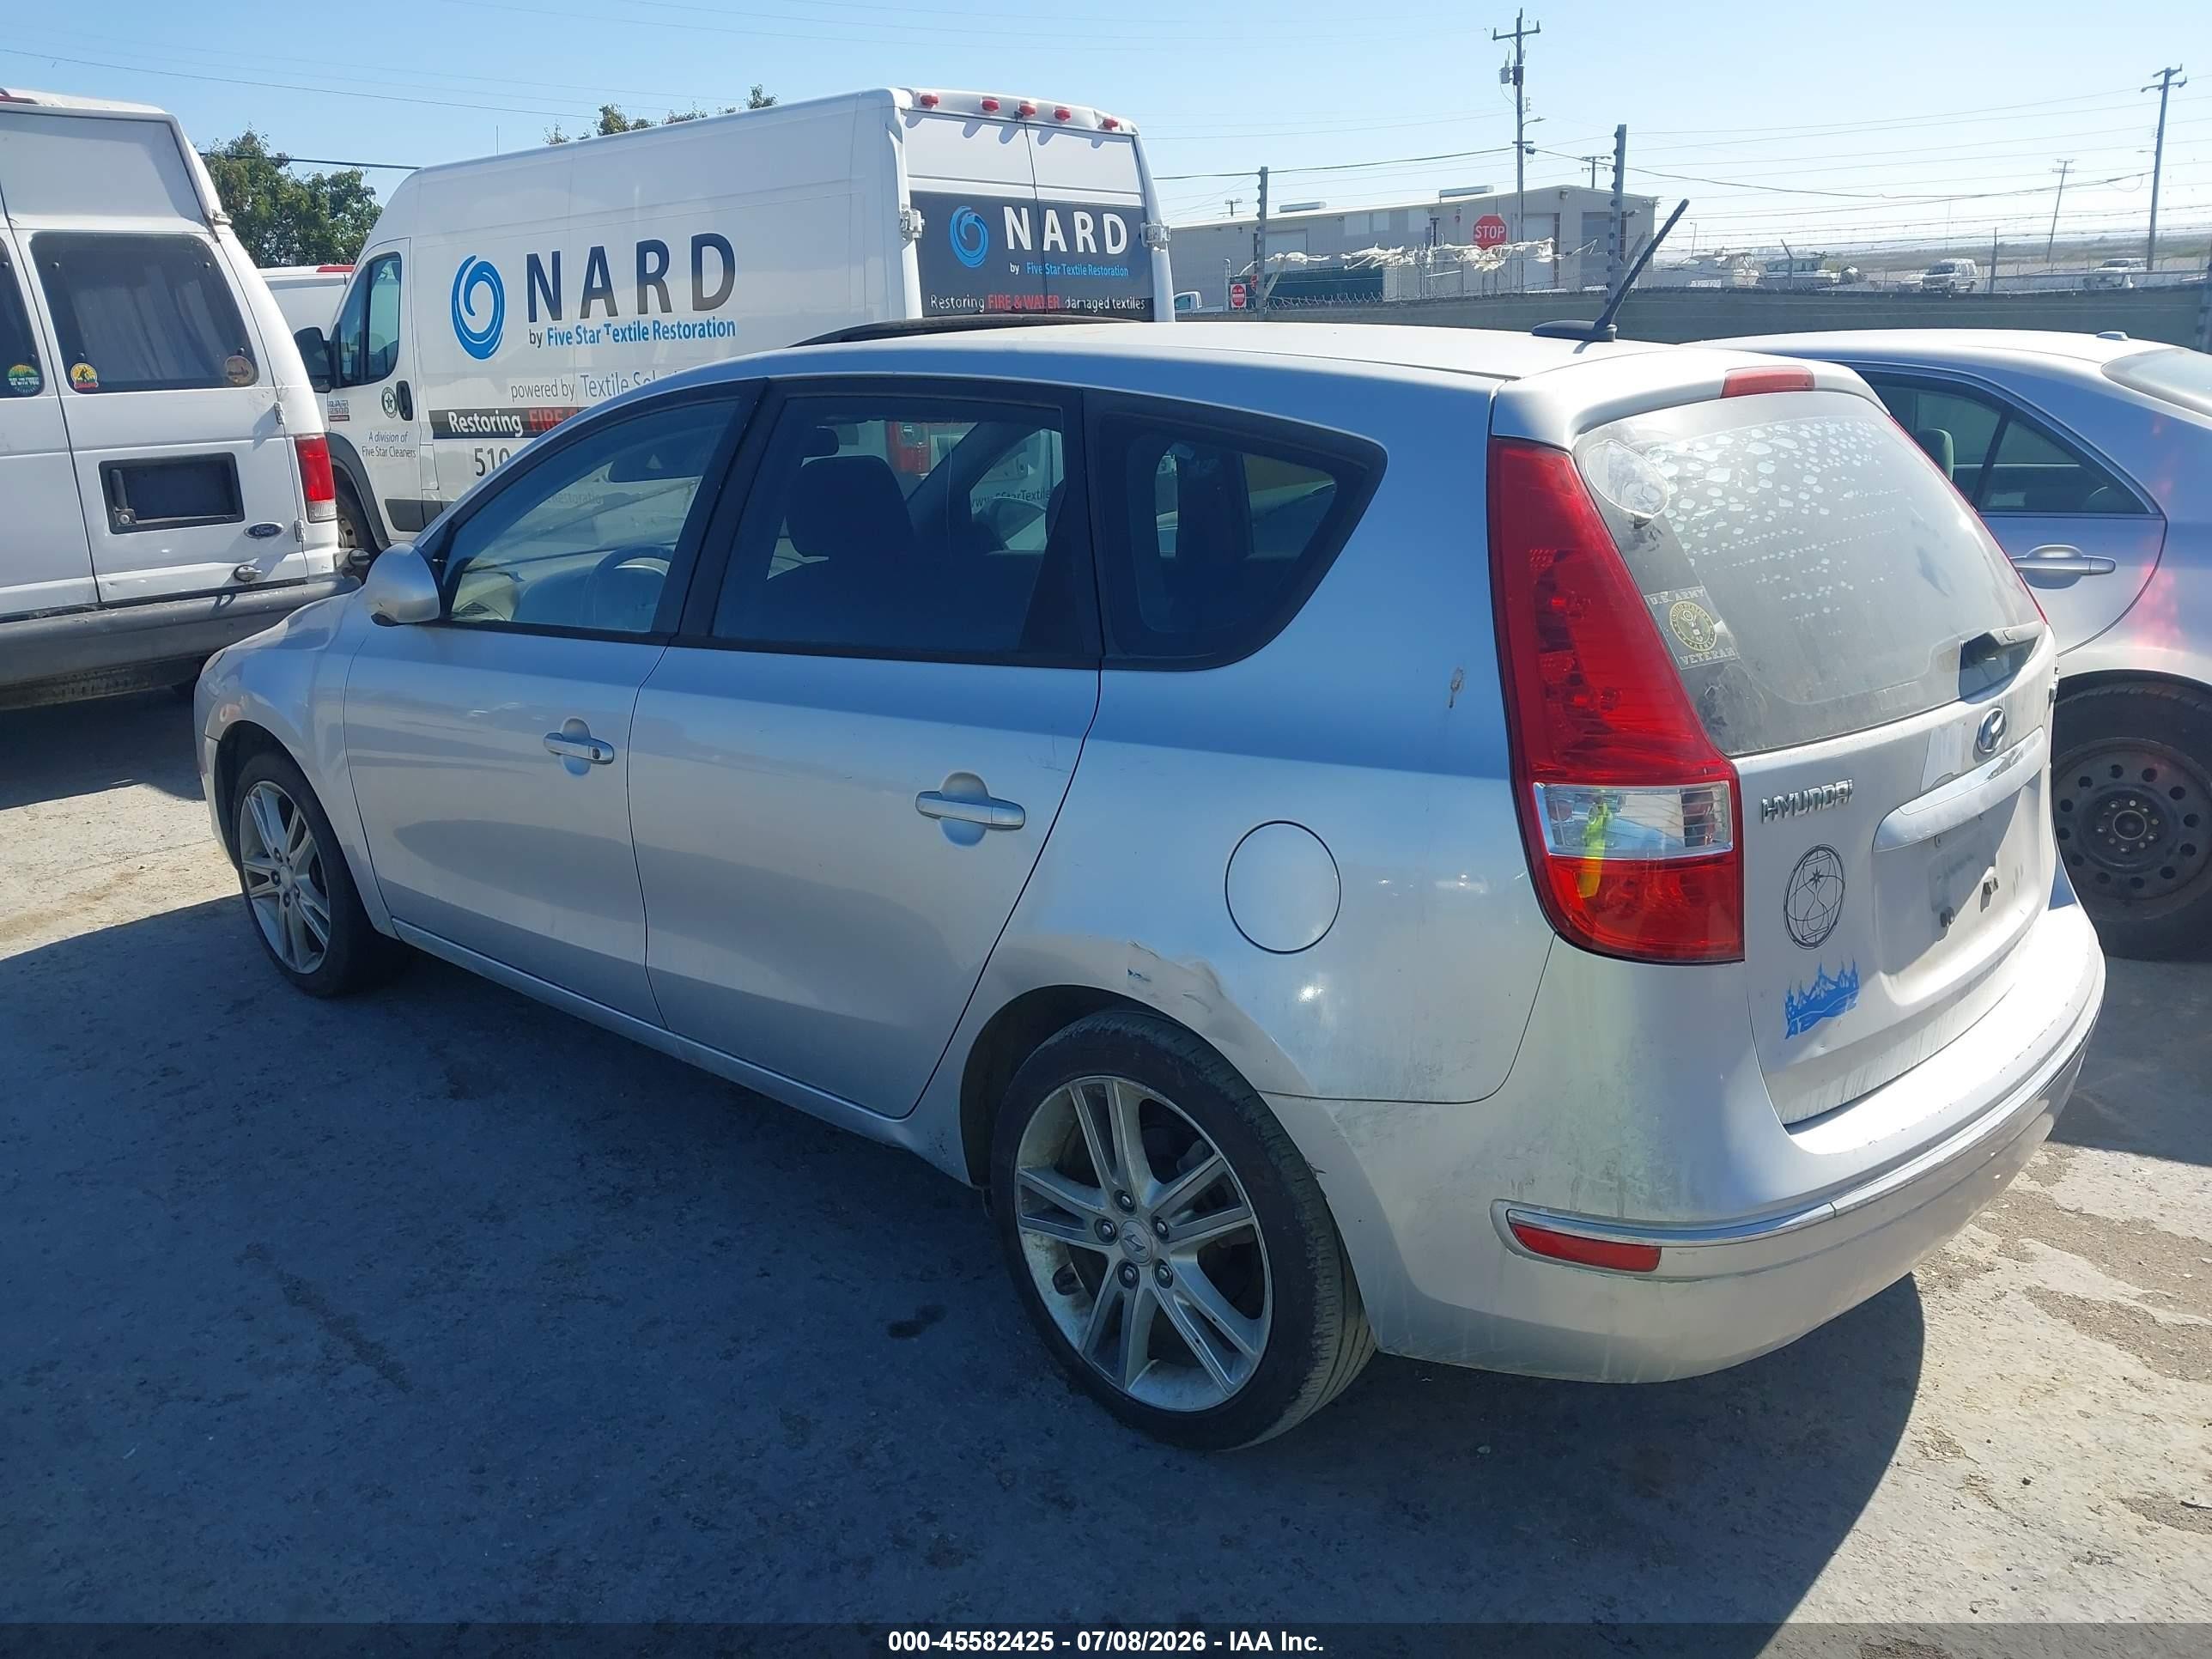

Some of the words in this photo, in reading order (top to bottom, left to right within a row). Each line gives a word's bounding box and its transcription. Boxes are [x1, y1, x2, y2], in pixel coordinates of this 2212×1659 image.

[1003, 206, 1127, 255] NARD
[1475, 226, 1505, 239] STOP
[526, 233, 736, 323] NARD
[1010, 263, 1019, 275] by
[1027, 262, 1044, 274] Five
[1045, 264, 1060, 275] Star
[1062, 264, 1087, 276] Textile
[1088, 264, 1128, 277] Restoration
[930, 295, 985, 313] Restoring
[988, 295, 1012, 309] FIRE
[1014, 295, 1024, 309] &
[1023, 295, 1060, 309] WATER
[1066, 296, 1109, 314] damaged
[1112, 297, 1146, 311] textiles
[529, 329, 543, 349] by
[547, 326, 573, 347] Five
[575, 324, 601, 345] Star
[604, 320, 649, 343] Textile
[653, 316, 736, 341] Restoration
[511, 378, 558, 402] powered
[561, 379, 575, 402] by
[580, 372, 629, 398] Textile
[447, 410, 523, 438] Restoring
[528, 409, 564, 432] FIRE
[368, 431, 374, 441] A
[374, 430, 399, 443] division
[400, 430, 409, 442] of
[362, 446, 375, 457] Five
[375, 447, 387, 457] Star
[388, 446, 416, 458] Cleaners
[474, 447, 511, 477] 510
[1675, 589, 1705, 602] ARMY
[1680, 647, 1735, 665] VETERAN
[1761, 779, 1853, 824] HYUNDAI
